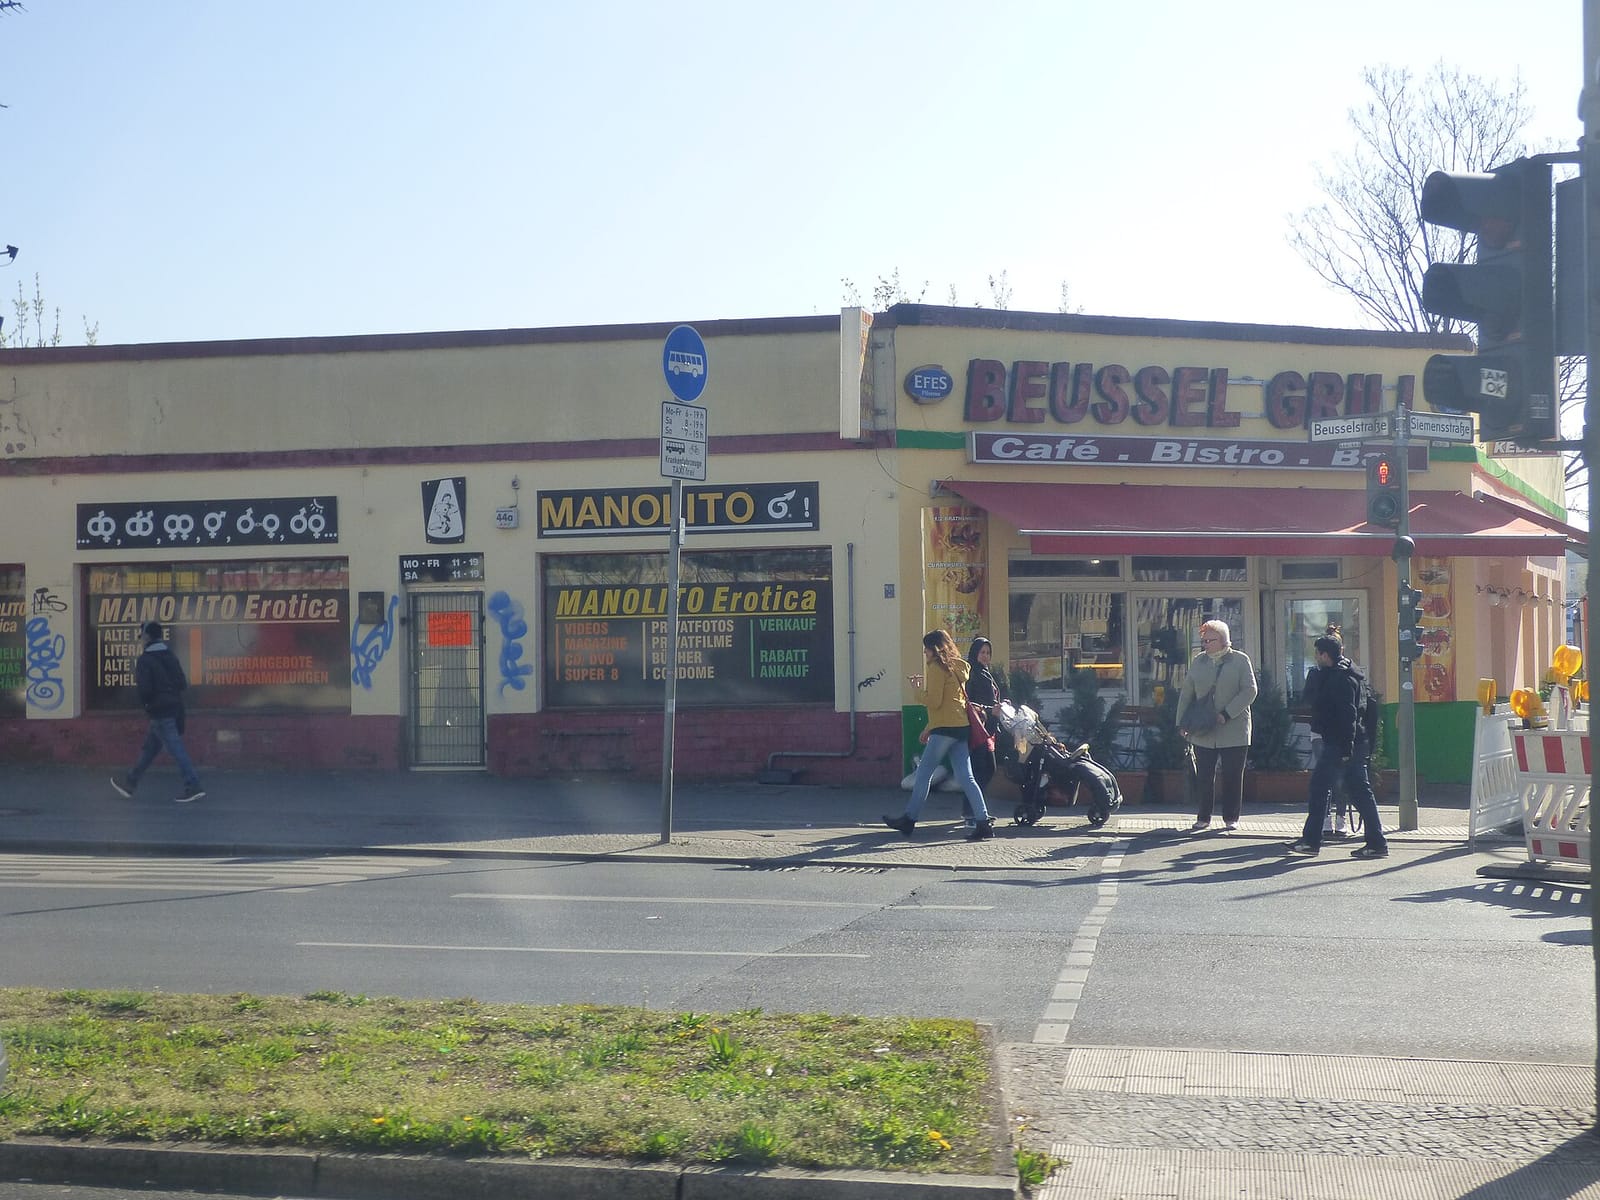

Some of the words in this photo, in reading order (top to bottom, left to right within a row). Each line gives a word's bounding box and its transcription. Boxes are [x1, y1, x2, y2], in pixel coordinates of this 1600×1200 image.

[914, 374, 948, 390] EFES
[1486, 382, 1506, 395] OK
[963, 357, 1241, 427] BEUSSEL
[665, 416, 673, 425] Sa
[1314, 418, 1387, 436] Beusselstraße
[1410, 417, 1470, 437] Siemensstraße
[991, 438, 1100, 461] Café
[1150, 441, 1285, 466] Bistro
[540, 491, 755, 529] MANOLITO
[403, 559, 419, 569] MO
[427, 559, 440, 568] FR
[452, 558, 460, 567] 11
[469, 558, 479, 566] 19
[404, 571, 418, 580] SA
[452, 570, 461, 579] 11
[470, 569, 480, 578] 19
[711, 584, 817, 613] Erotica
[0, 602, 26, 617] LITO
[99, 594, 238, 623] MANOLITO
[244, 593, 339, 619] Erotica
[564, 622, 609, 635] VIDEOS
[651, 619, 735, 634] PRATFOTOS
[759, 618, 817, 632] VERKAUF
[104, 628, 130, 641] ALTE
[651, 634, 733, 649] PRATFILME
[564, 636, 628, 650] MAGAZINE
[590, 653, 614, 665] DVD
[652, 648, 703, 665] BÜHER
[759, 649, 809, 663] RABATT
[104, 659, 130, 672] ALTE
[759, 664, 810, 678] ANKAUF
[206, 671, 329, 685] PRIVATSAMMLUNGEN
[564, 668, 605, 681] SUPER
[611, 668, 619, 681] 8
